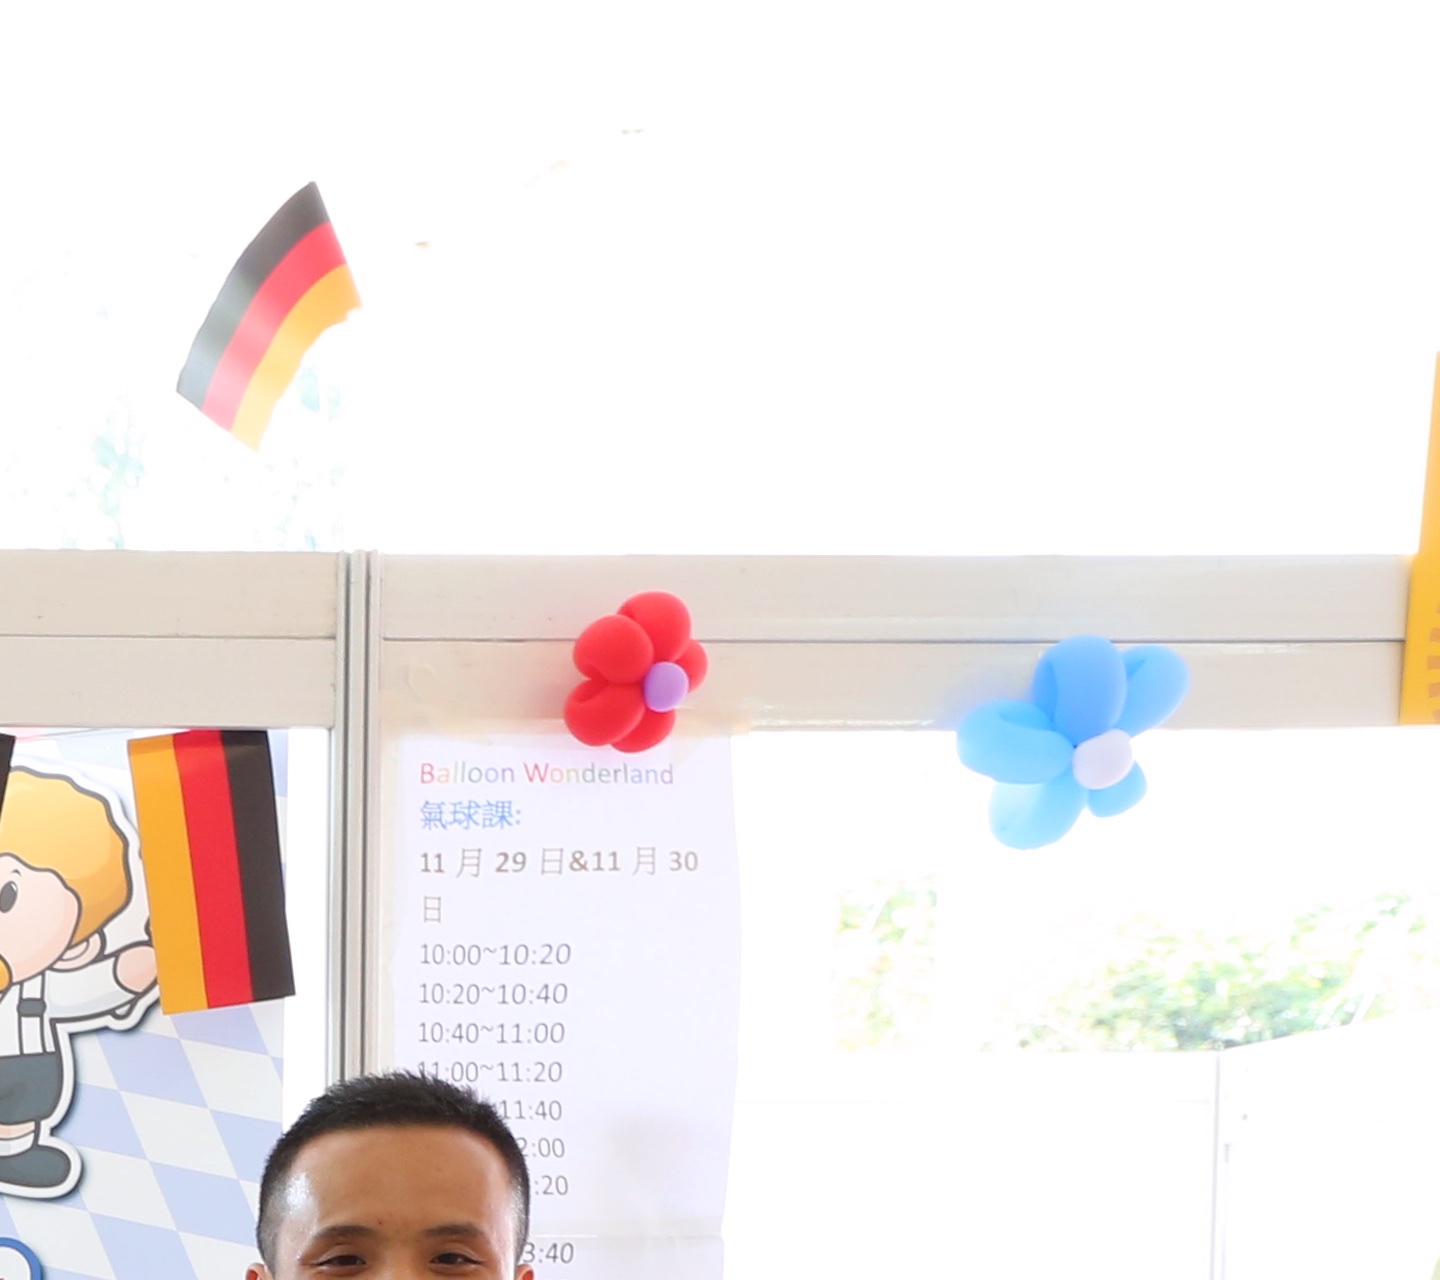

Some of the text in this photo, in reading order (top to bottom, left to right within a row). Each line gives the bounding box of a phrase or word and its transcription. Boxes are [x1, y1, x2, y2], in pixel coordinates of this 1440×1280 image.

[420, 762, 674, 785] Balloon Wonderland
[420, 852, 445, 873] 11
[495, 851, 527, 873] 29
[669, 850, 698, 873] 30
[420, 943, 571, 965] 10:00~10:20
[418, 983, 568, 1005] 10:20~10:40
[418, 1022, 565, 1043] 10:40~11:00
[500, 1100, 562, 1121] 11:40
[517, 1137, 565, 1158] 2:00
[534, 1175, 568, 1196] :20
[521, 1242, 574, 1263] 3:40
